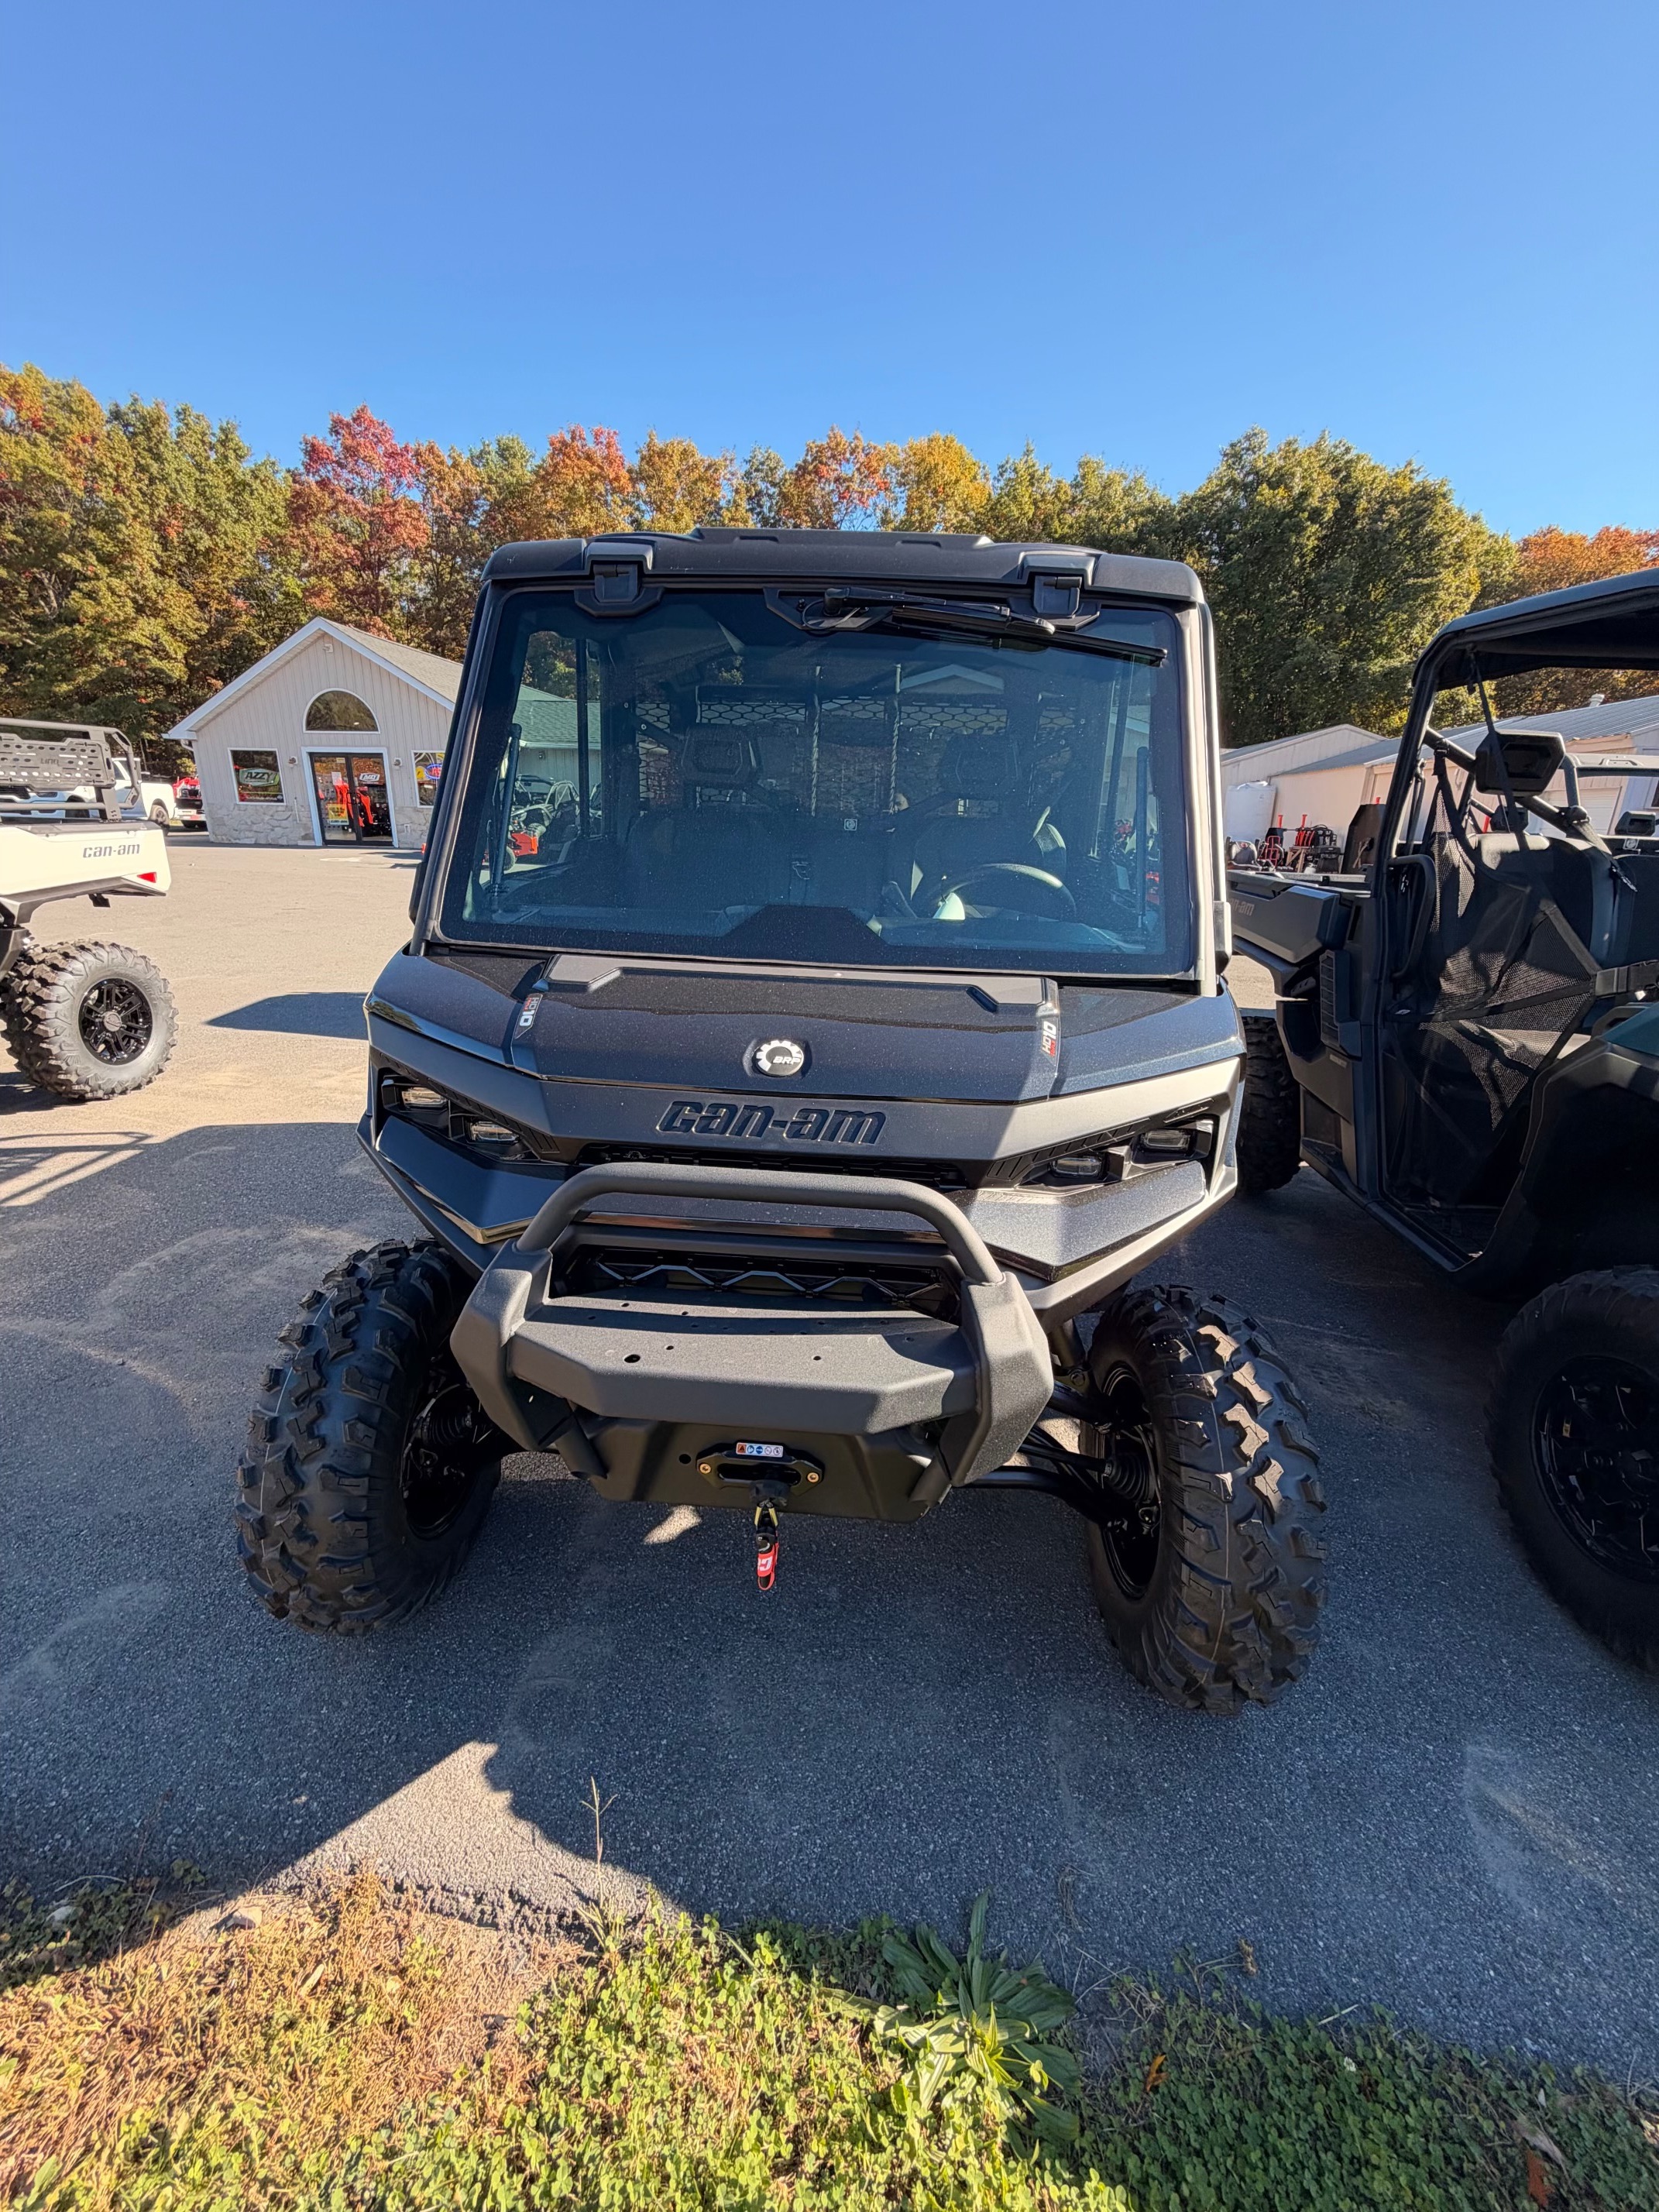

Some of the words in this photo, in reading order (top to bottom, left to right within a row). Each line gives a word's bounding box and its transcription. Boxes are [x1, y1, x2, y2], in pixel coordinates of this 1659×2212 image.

[245, 771, 273, 781] AZZY
[82, 843, 140, 858] can-am
[772, 1056, 801, 1065] BRP
[655, 1101, 887, 1146] can-am
